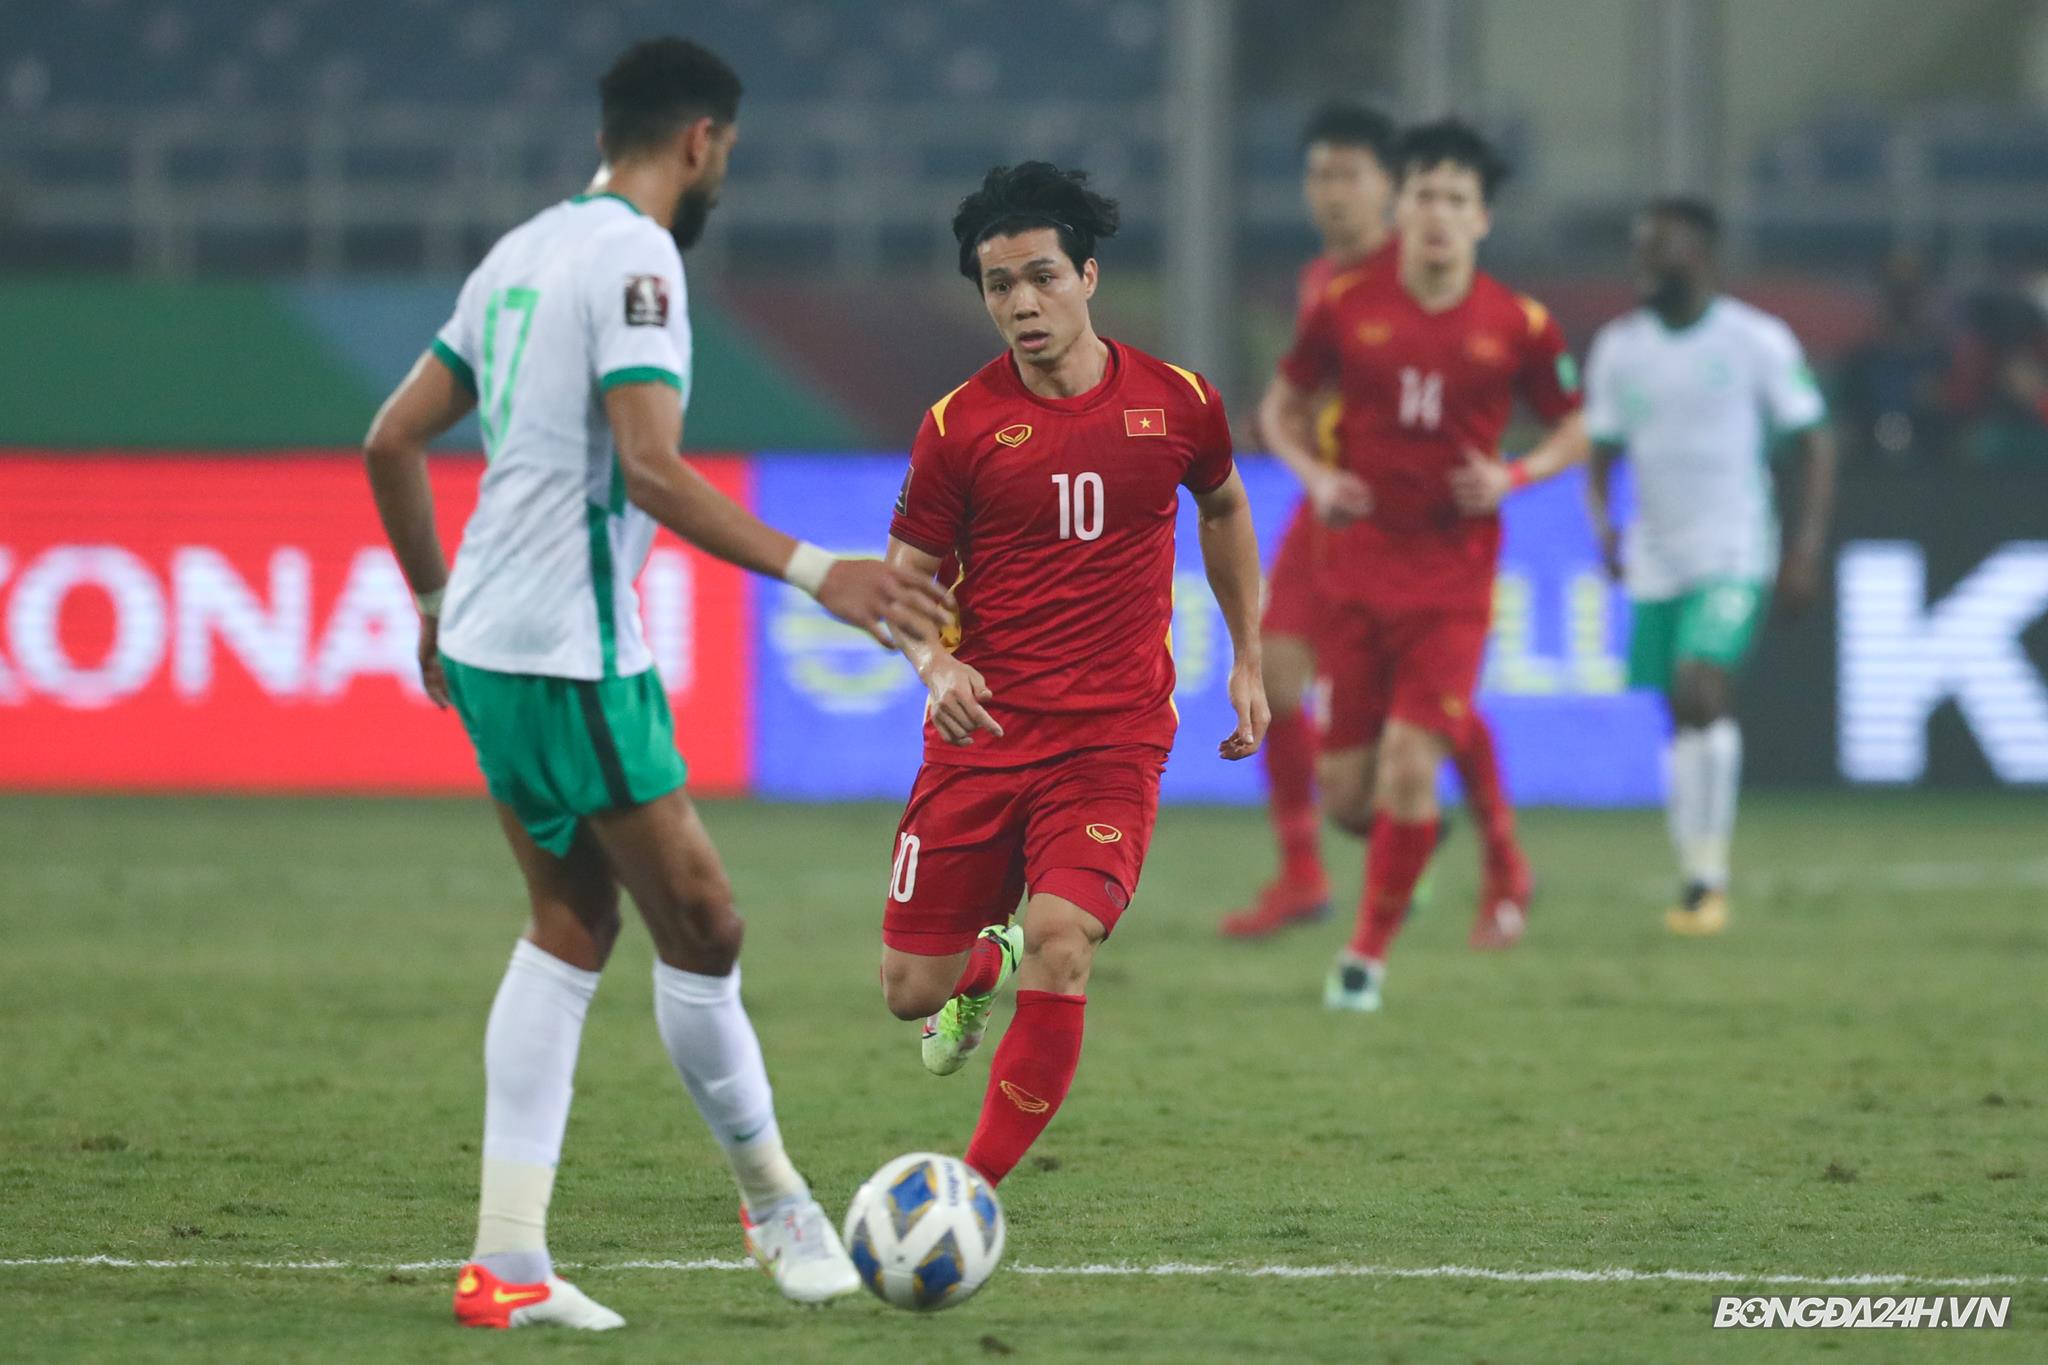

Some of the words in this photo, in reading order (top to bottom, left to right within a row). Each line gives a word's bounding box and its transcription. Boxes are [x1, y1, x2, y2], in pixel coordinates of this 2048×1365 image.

[482, 286, 541, 466] 17
[1397, 365, 1445, 432] 14
[1051, 471, 1105, 541] 10
[888, 831, 921, 903] 10
